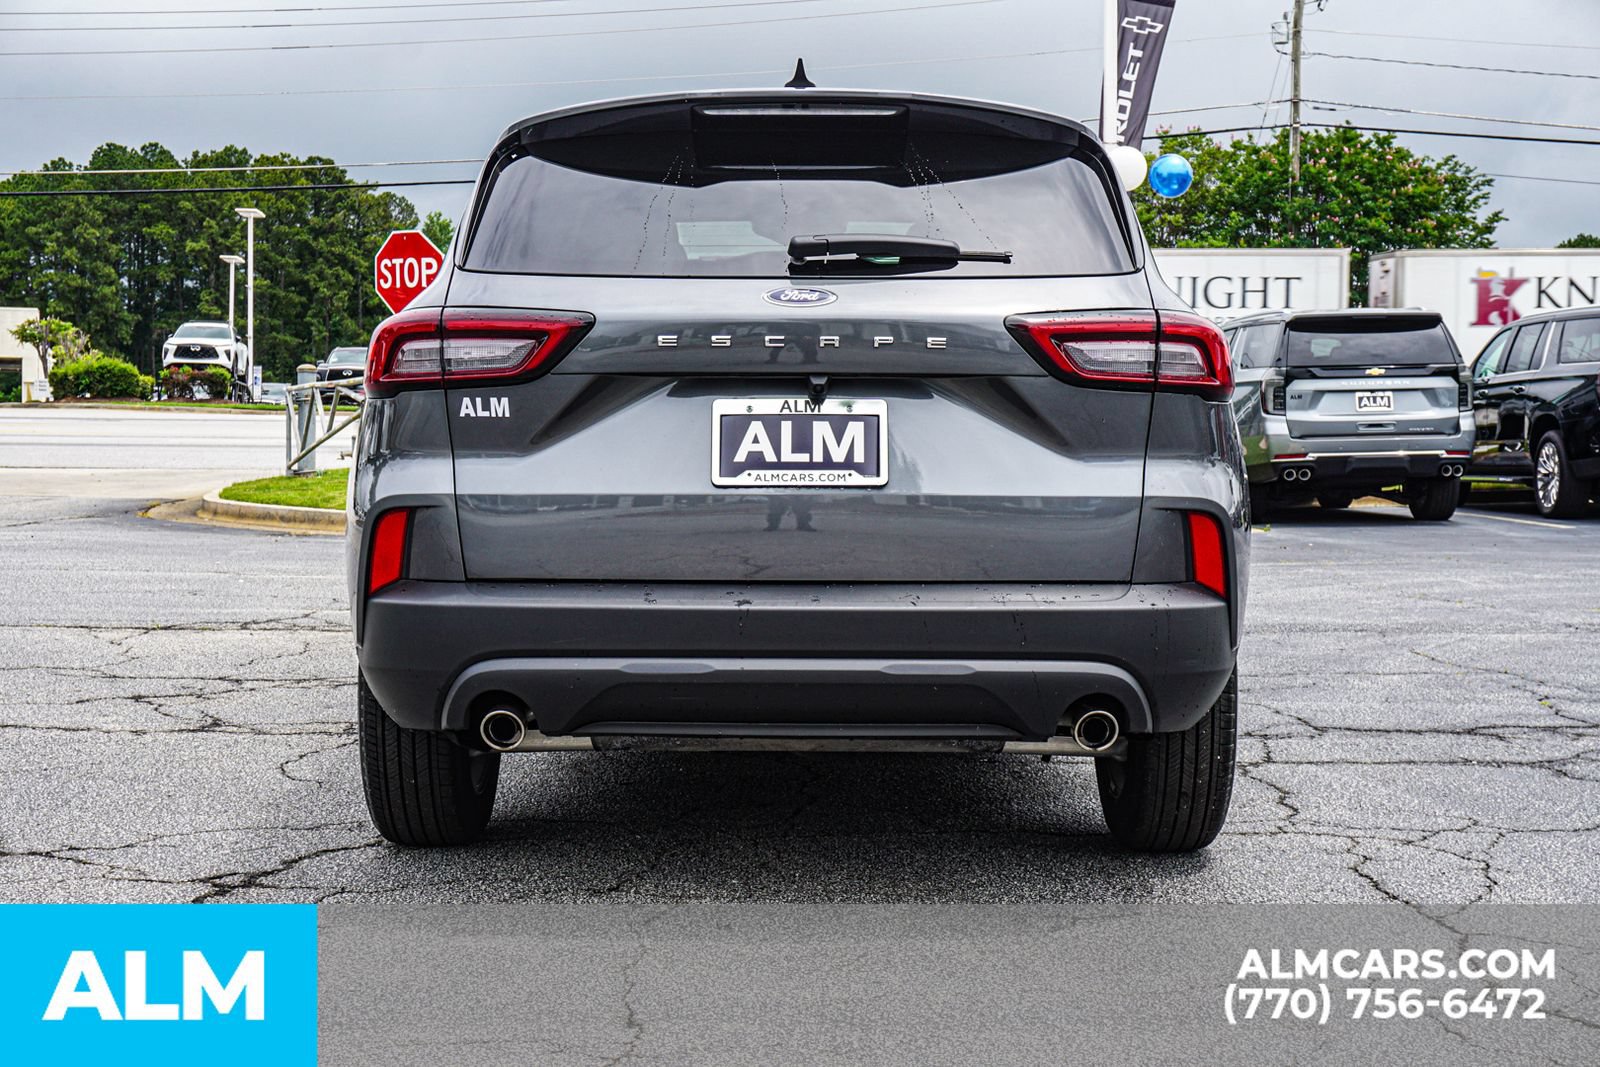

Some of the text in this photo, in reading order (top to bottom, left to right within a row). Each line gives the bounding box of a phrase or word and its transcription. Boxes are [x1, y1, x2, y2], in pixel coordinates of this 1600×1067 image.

[379, 257, 438, 289] STOP
[781, 289, 819, 300] Ford
[657, 335, 947, 349] ESCAPE
[459, 397, 510, 418] ALM
[780, 400, 821, 413] ALM
[1360, 397, 1389, 407] ALM
[733, 420, 865, 463] ALM
[754, 473, 847, 482] ALMCARS.COM
